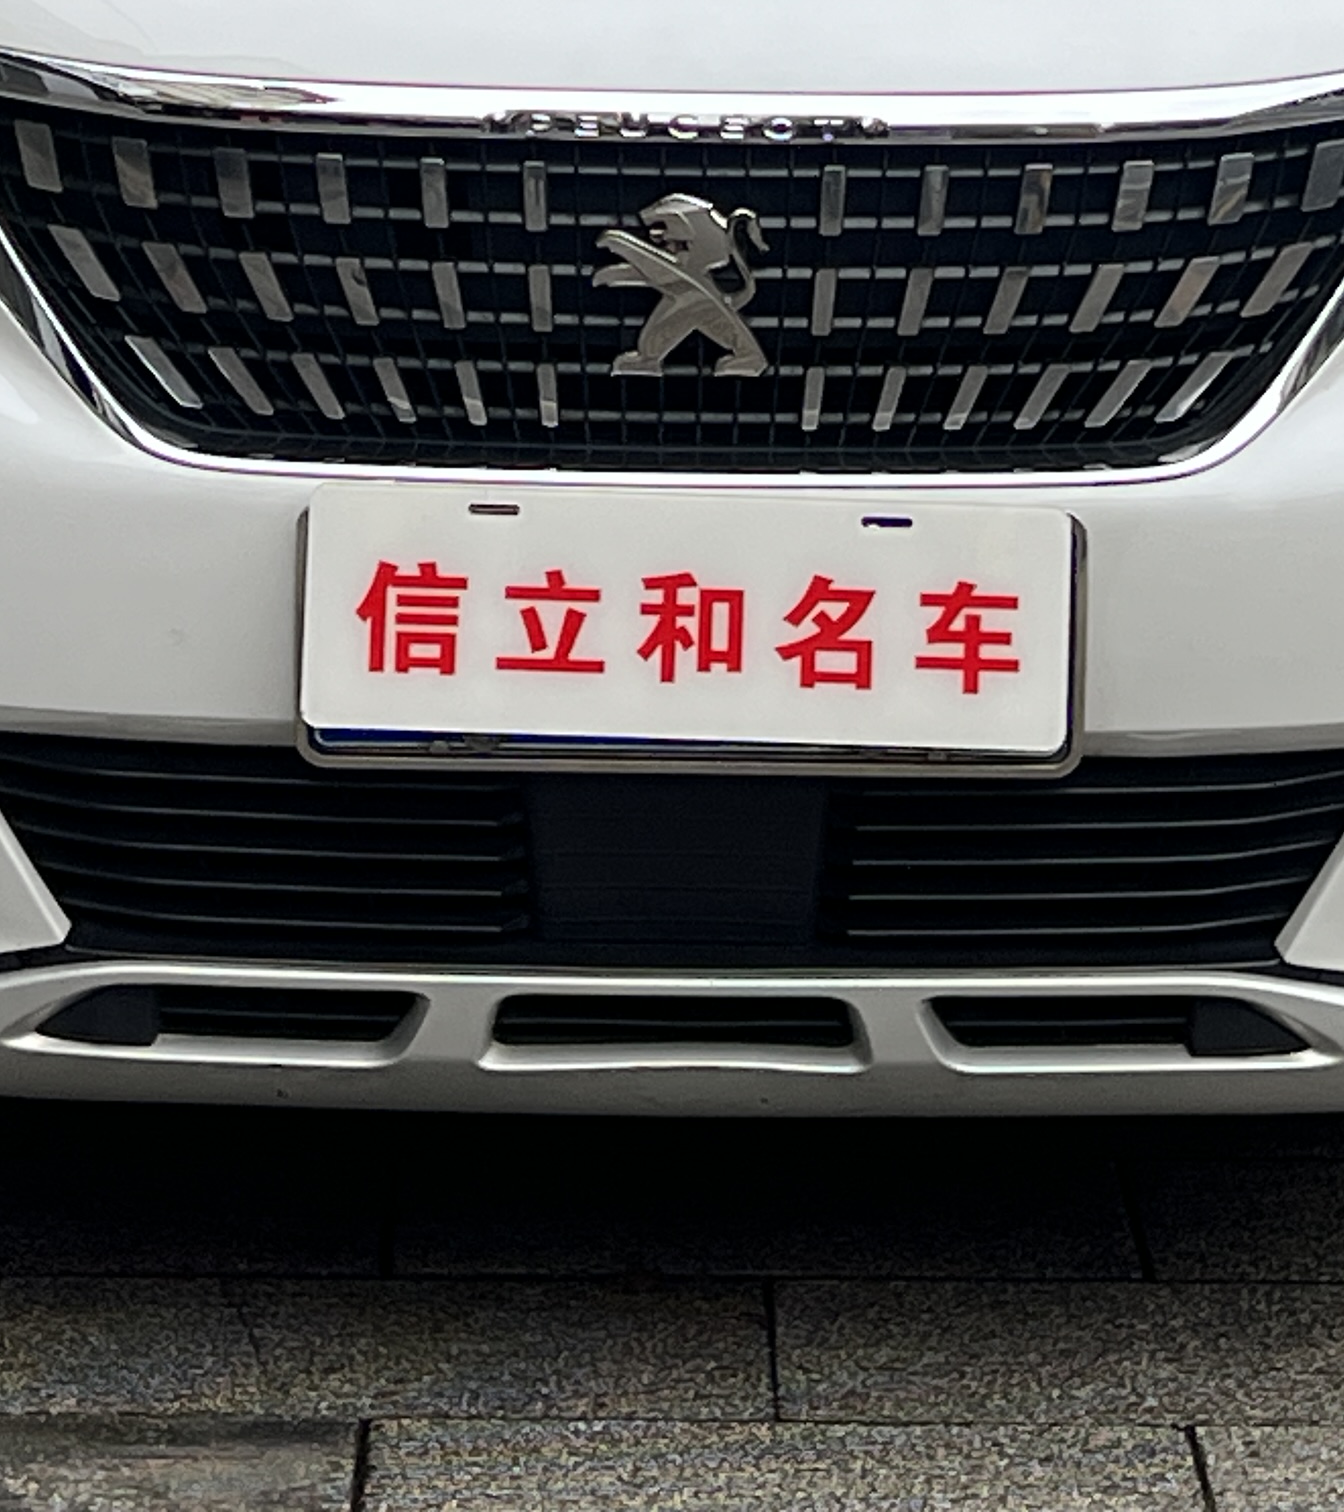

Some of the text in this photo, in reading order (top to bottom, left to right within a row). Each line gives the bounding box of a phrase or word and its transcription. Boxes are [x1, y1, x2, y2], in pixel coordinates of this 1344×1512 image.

[355, 560, 1021, 696] 信立和名车
